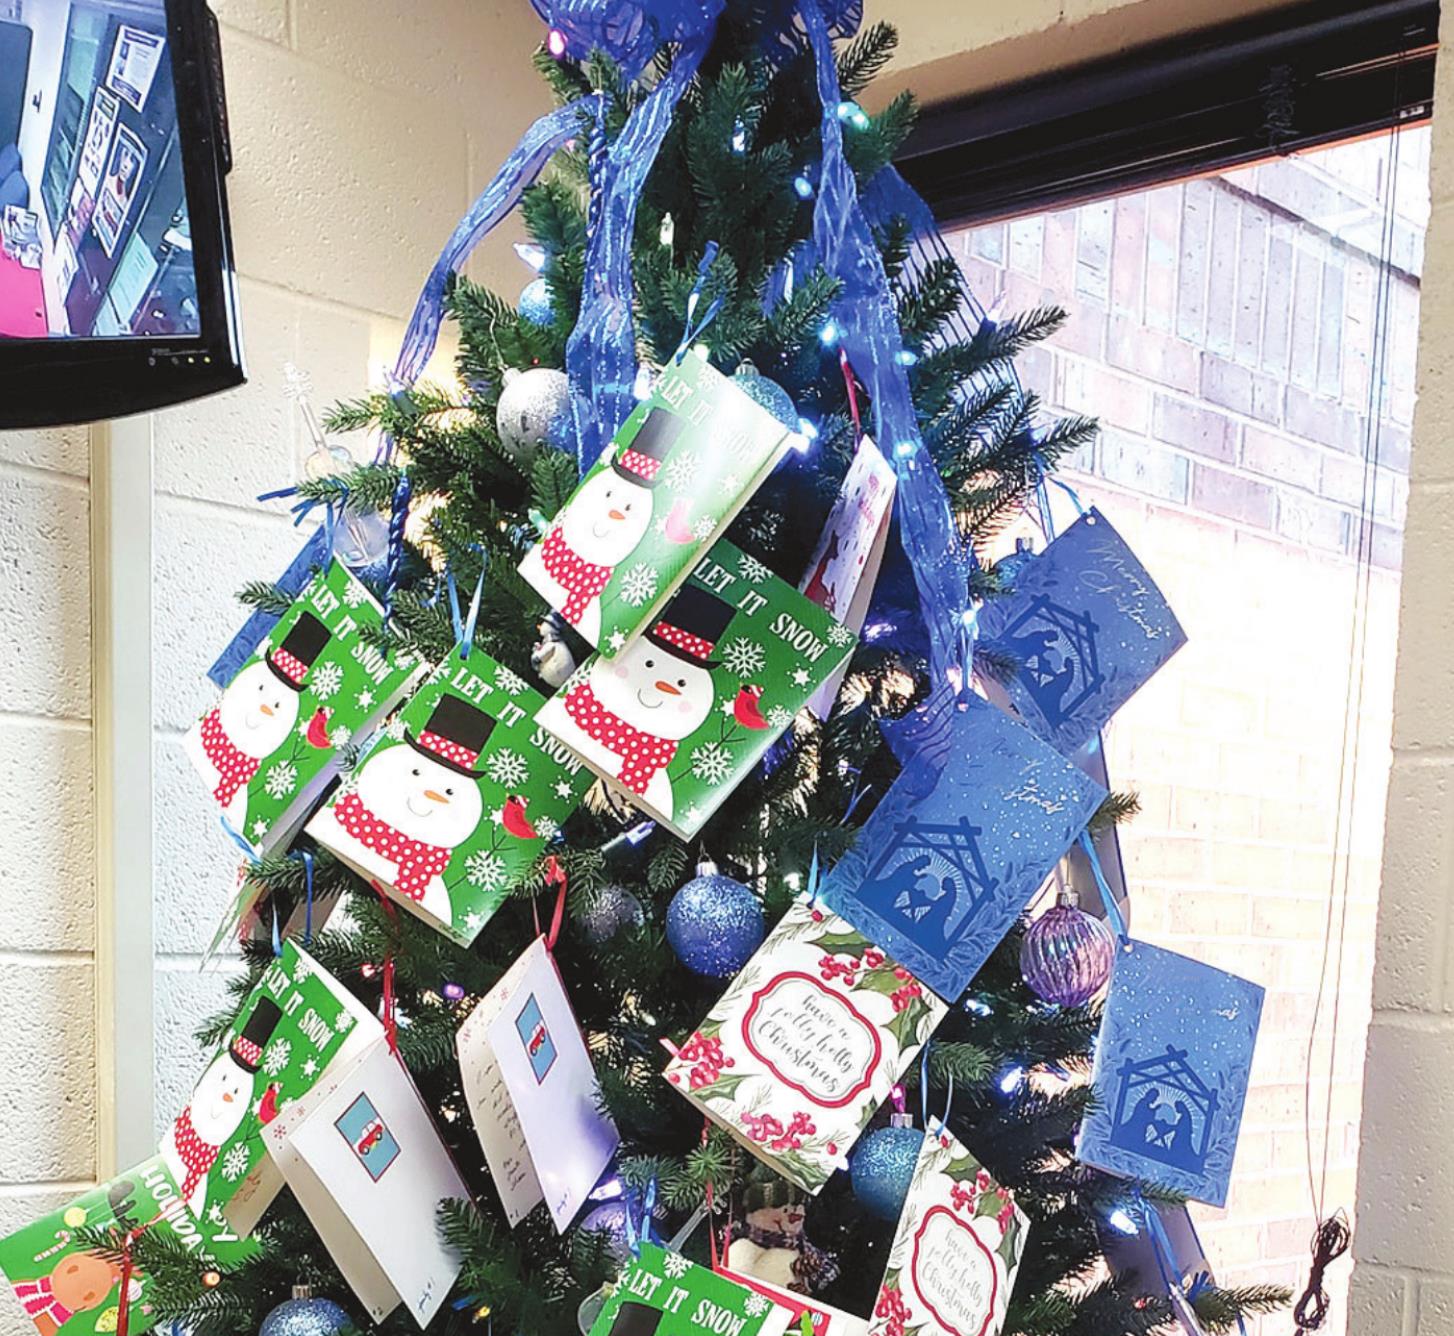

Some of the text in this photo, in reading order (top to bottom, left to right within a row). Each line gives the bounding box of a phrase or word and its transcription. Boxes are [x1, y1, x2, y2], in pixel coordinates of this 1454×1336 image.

[661, 376, 694, 409] LET
[311, 584, 394, 686] LET IT SNOW
[693, 557, 828, 663] LET IT SNOW
[450, 667, 584, 776] LET IT SNOW
[267, 966, 335, 1052] LET IT SNOW
[769, 1007, 854, 1074] jolly holly
[802, 994, 850, 1040] have a
[758, 1020, 840, 1093] Christmas
[628, 1269, 663, 1301] LET
[663, 1286, 690, 1314] IT
[922, 1260, 976, 1330] Christmas
